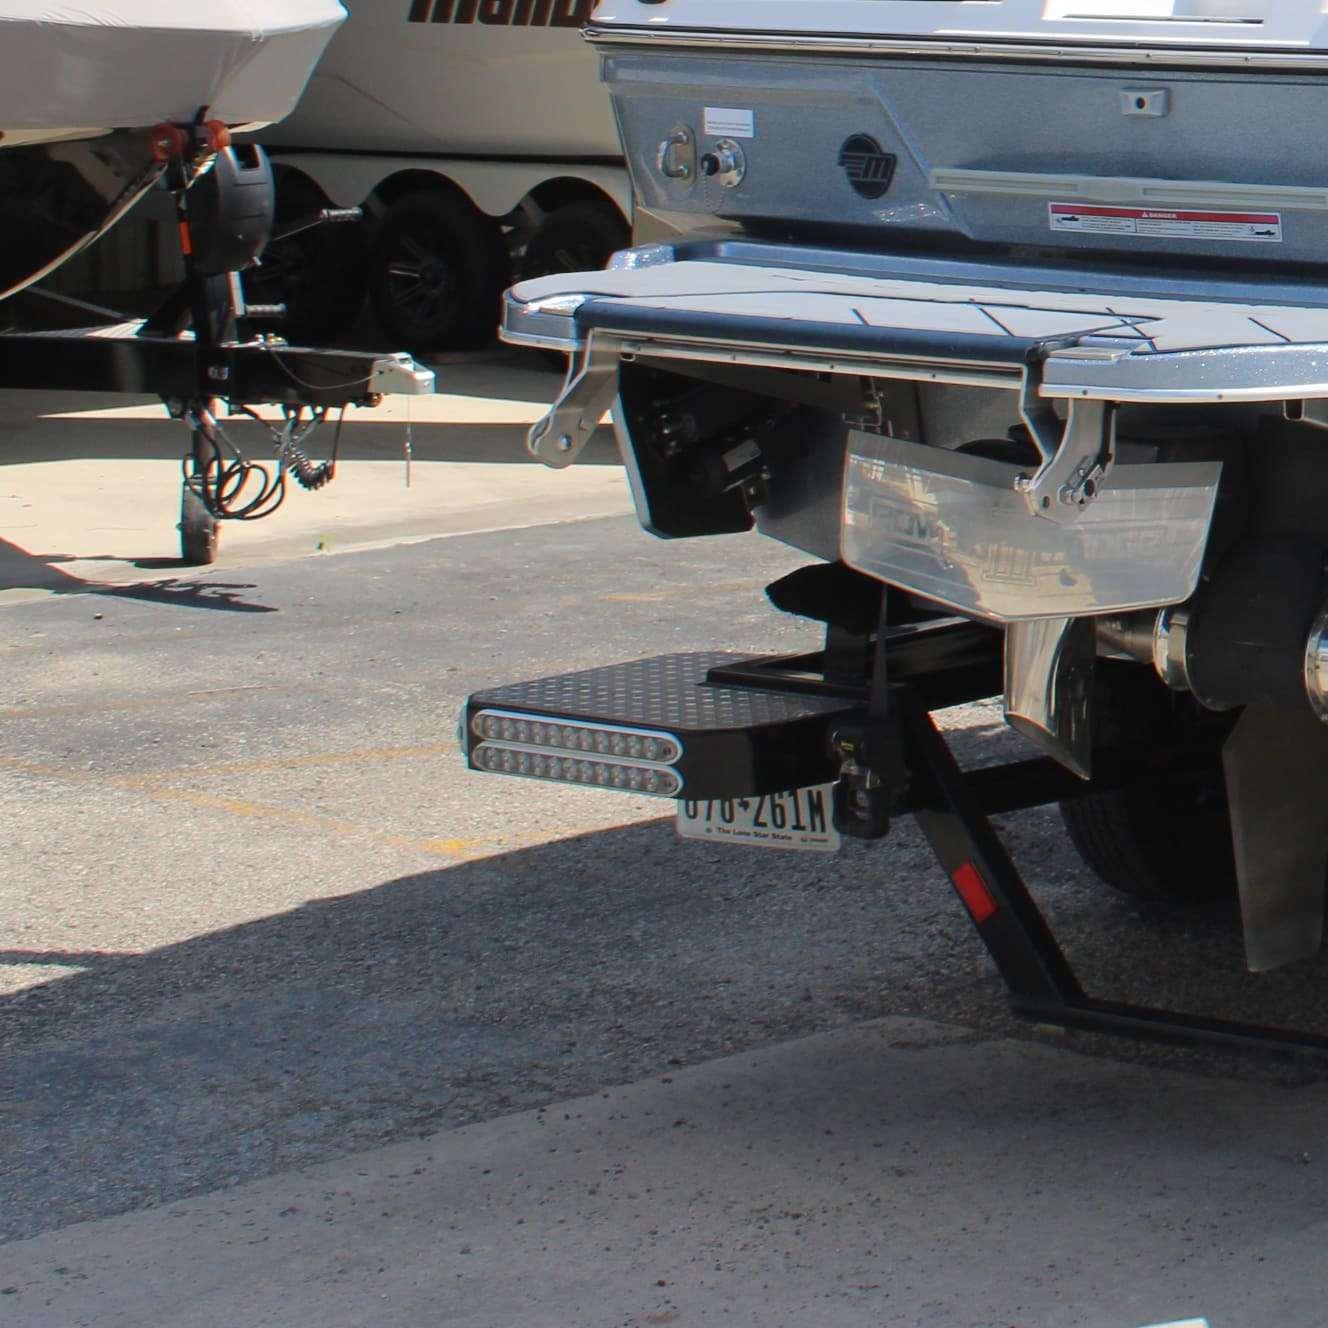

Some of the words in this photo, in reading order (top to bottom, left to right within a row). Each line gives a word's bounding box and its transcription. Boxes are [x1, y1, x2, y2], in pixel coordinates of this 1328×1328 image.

[717, 826, 730, 835] The
[732, 828, 751, 837] Lone
[752, 830, 769, 839] Star
[771, 832, 793, 841] State
